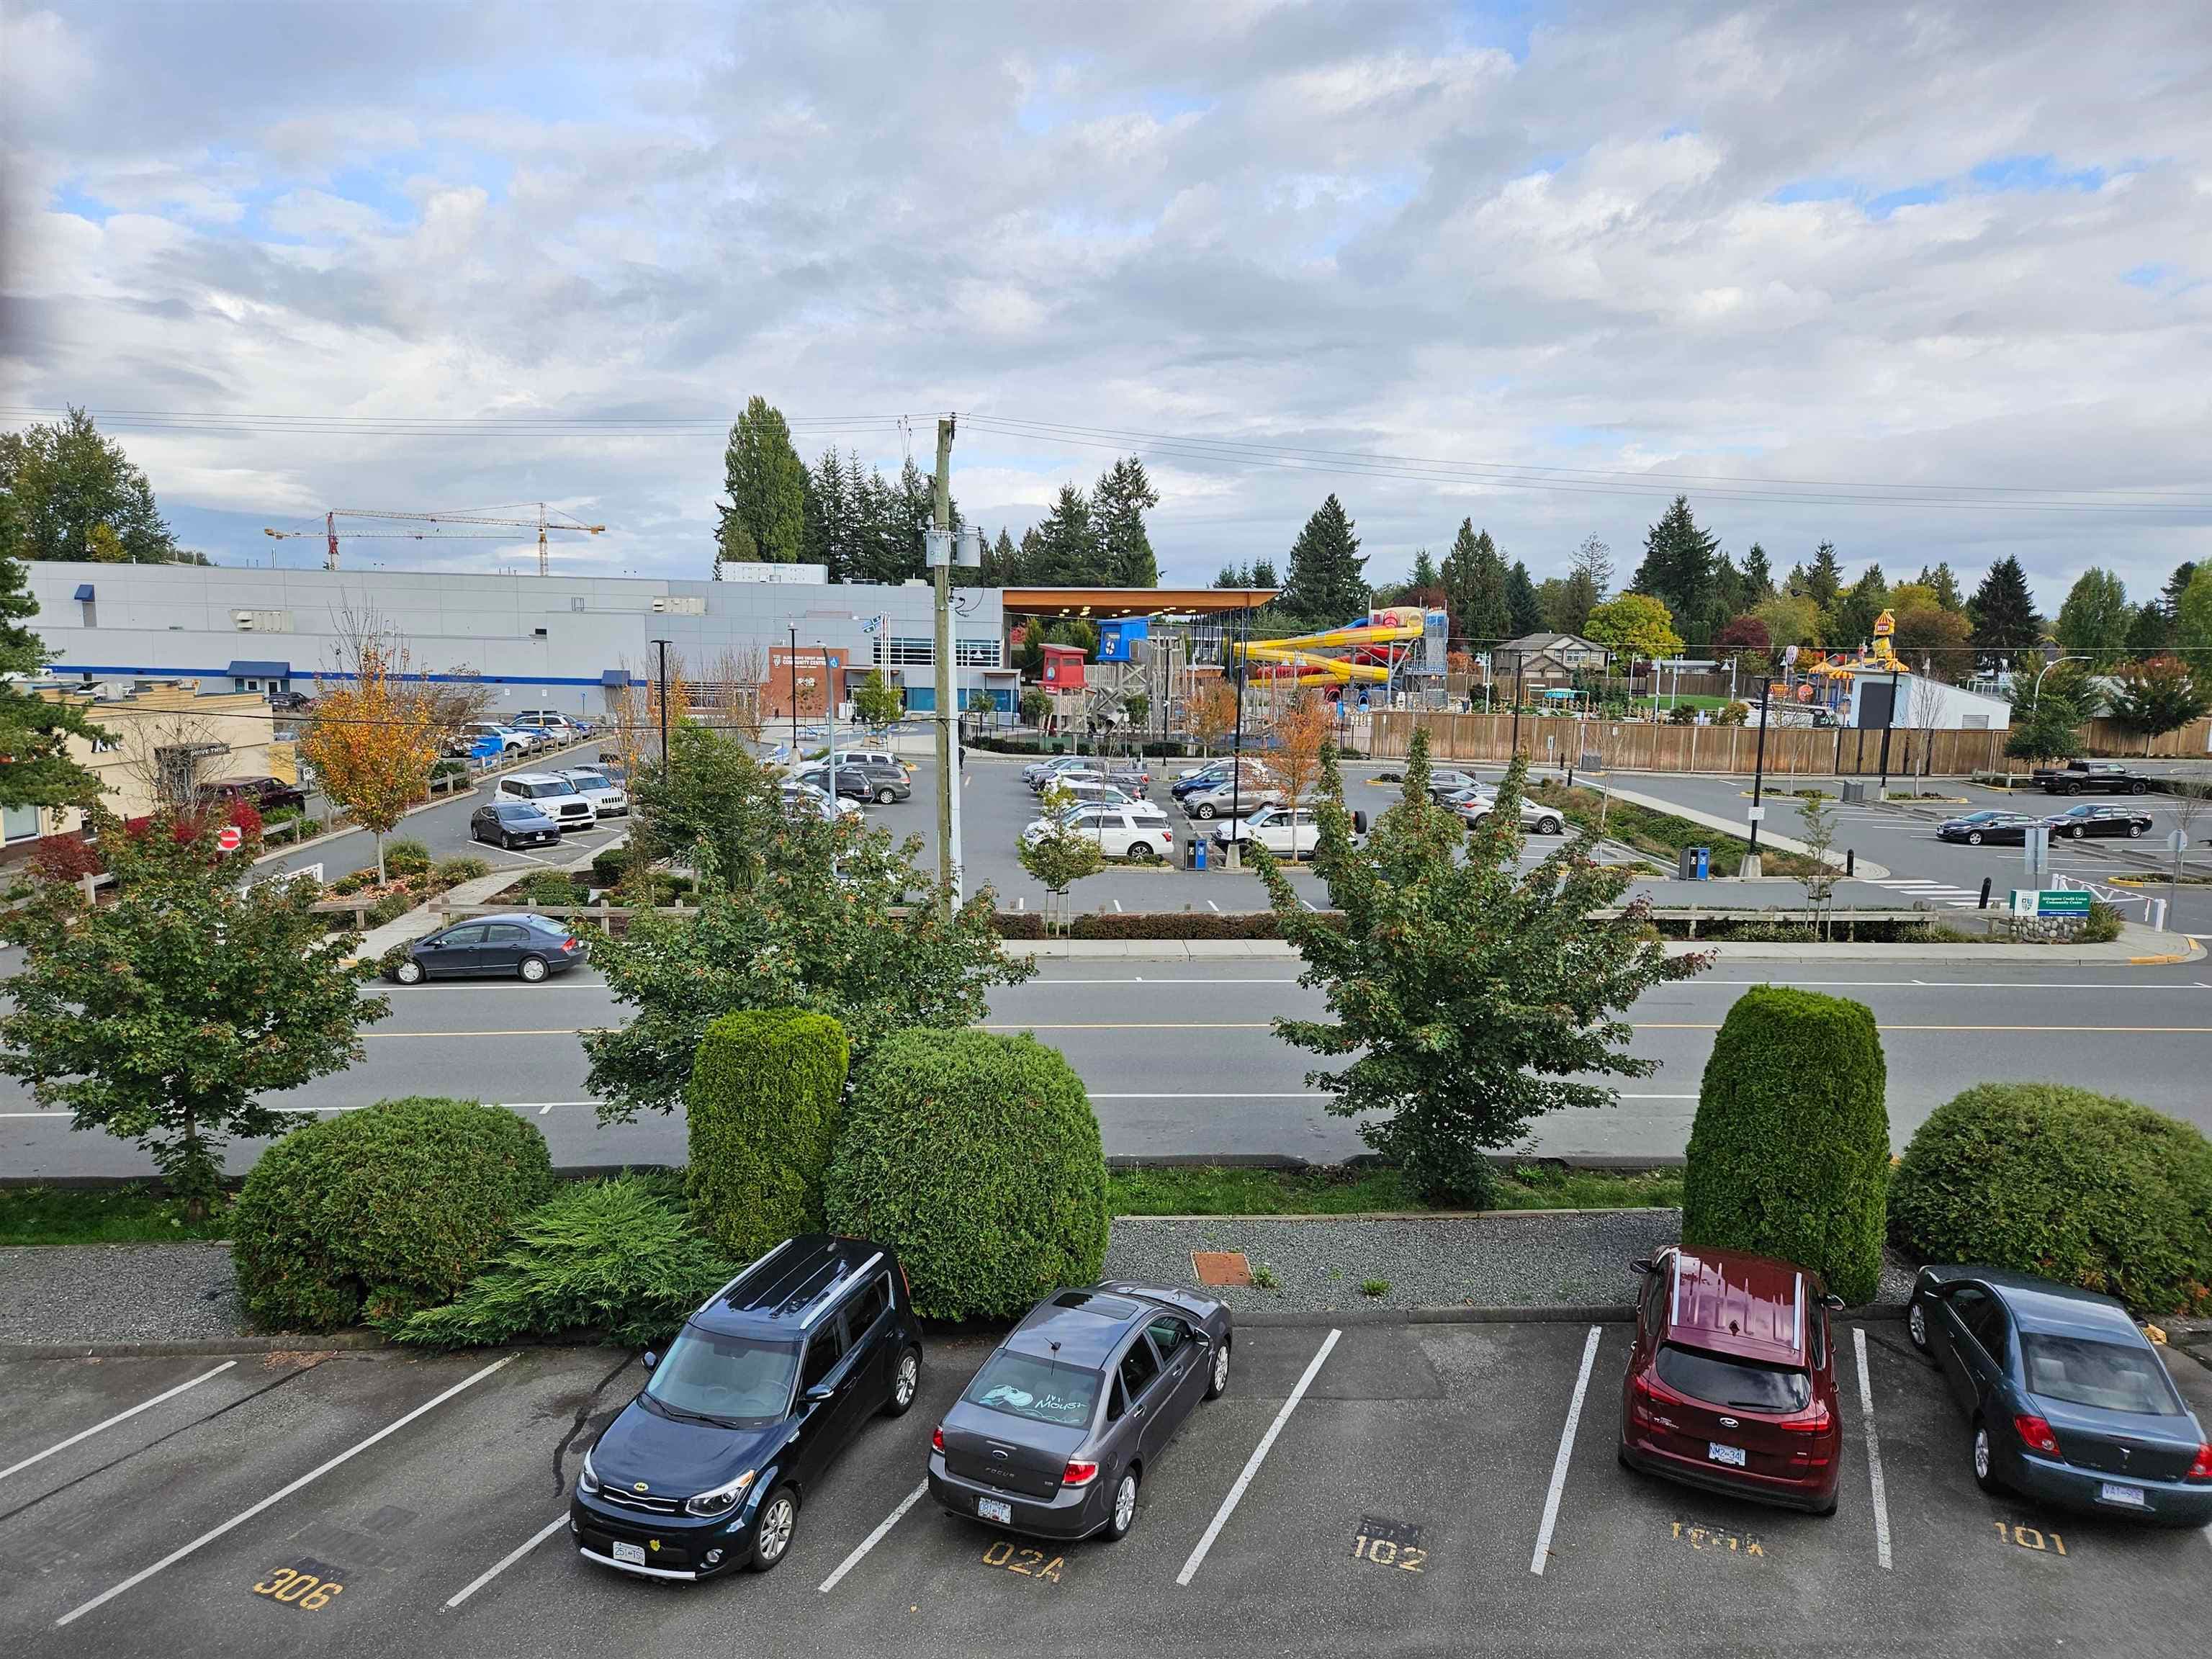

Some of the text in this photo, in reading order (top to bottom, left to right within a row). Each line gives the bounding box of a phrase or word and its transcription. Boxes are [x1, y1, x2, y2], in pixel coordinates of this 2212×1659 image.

[1354, 1535, 1429, 1573] 102
[1993, 1521, 2067, 1555] 101
[253, 1568, 343, 1610] 306
